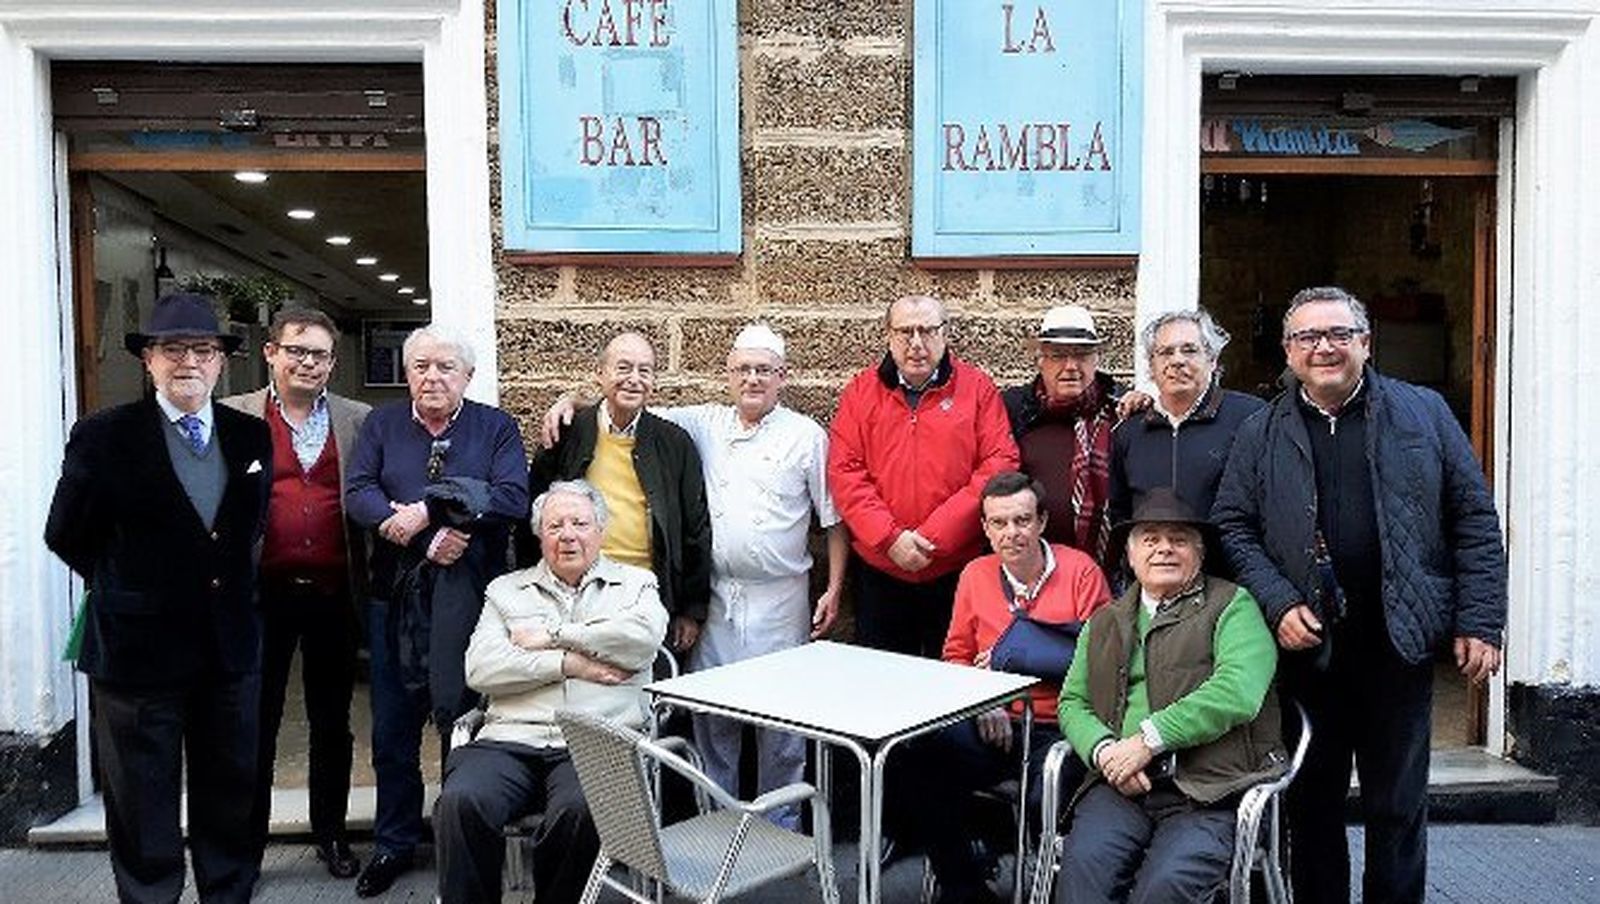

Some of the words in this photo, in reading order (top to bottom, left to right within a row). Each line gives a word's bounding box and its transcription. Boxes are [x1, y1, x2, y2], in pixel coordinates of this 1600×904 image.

[1002, 4, 1056, 53] LA
[580, 116, 668, 166] BAR
[941, 121, 1112, 171] RAMBLA
